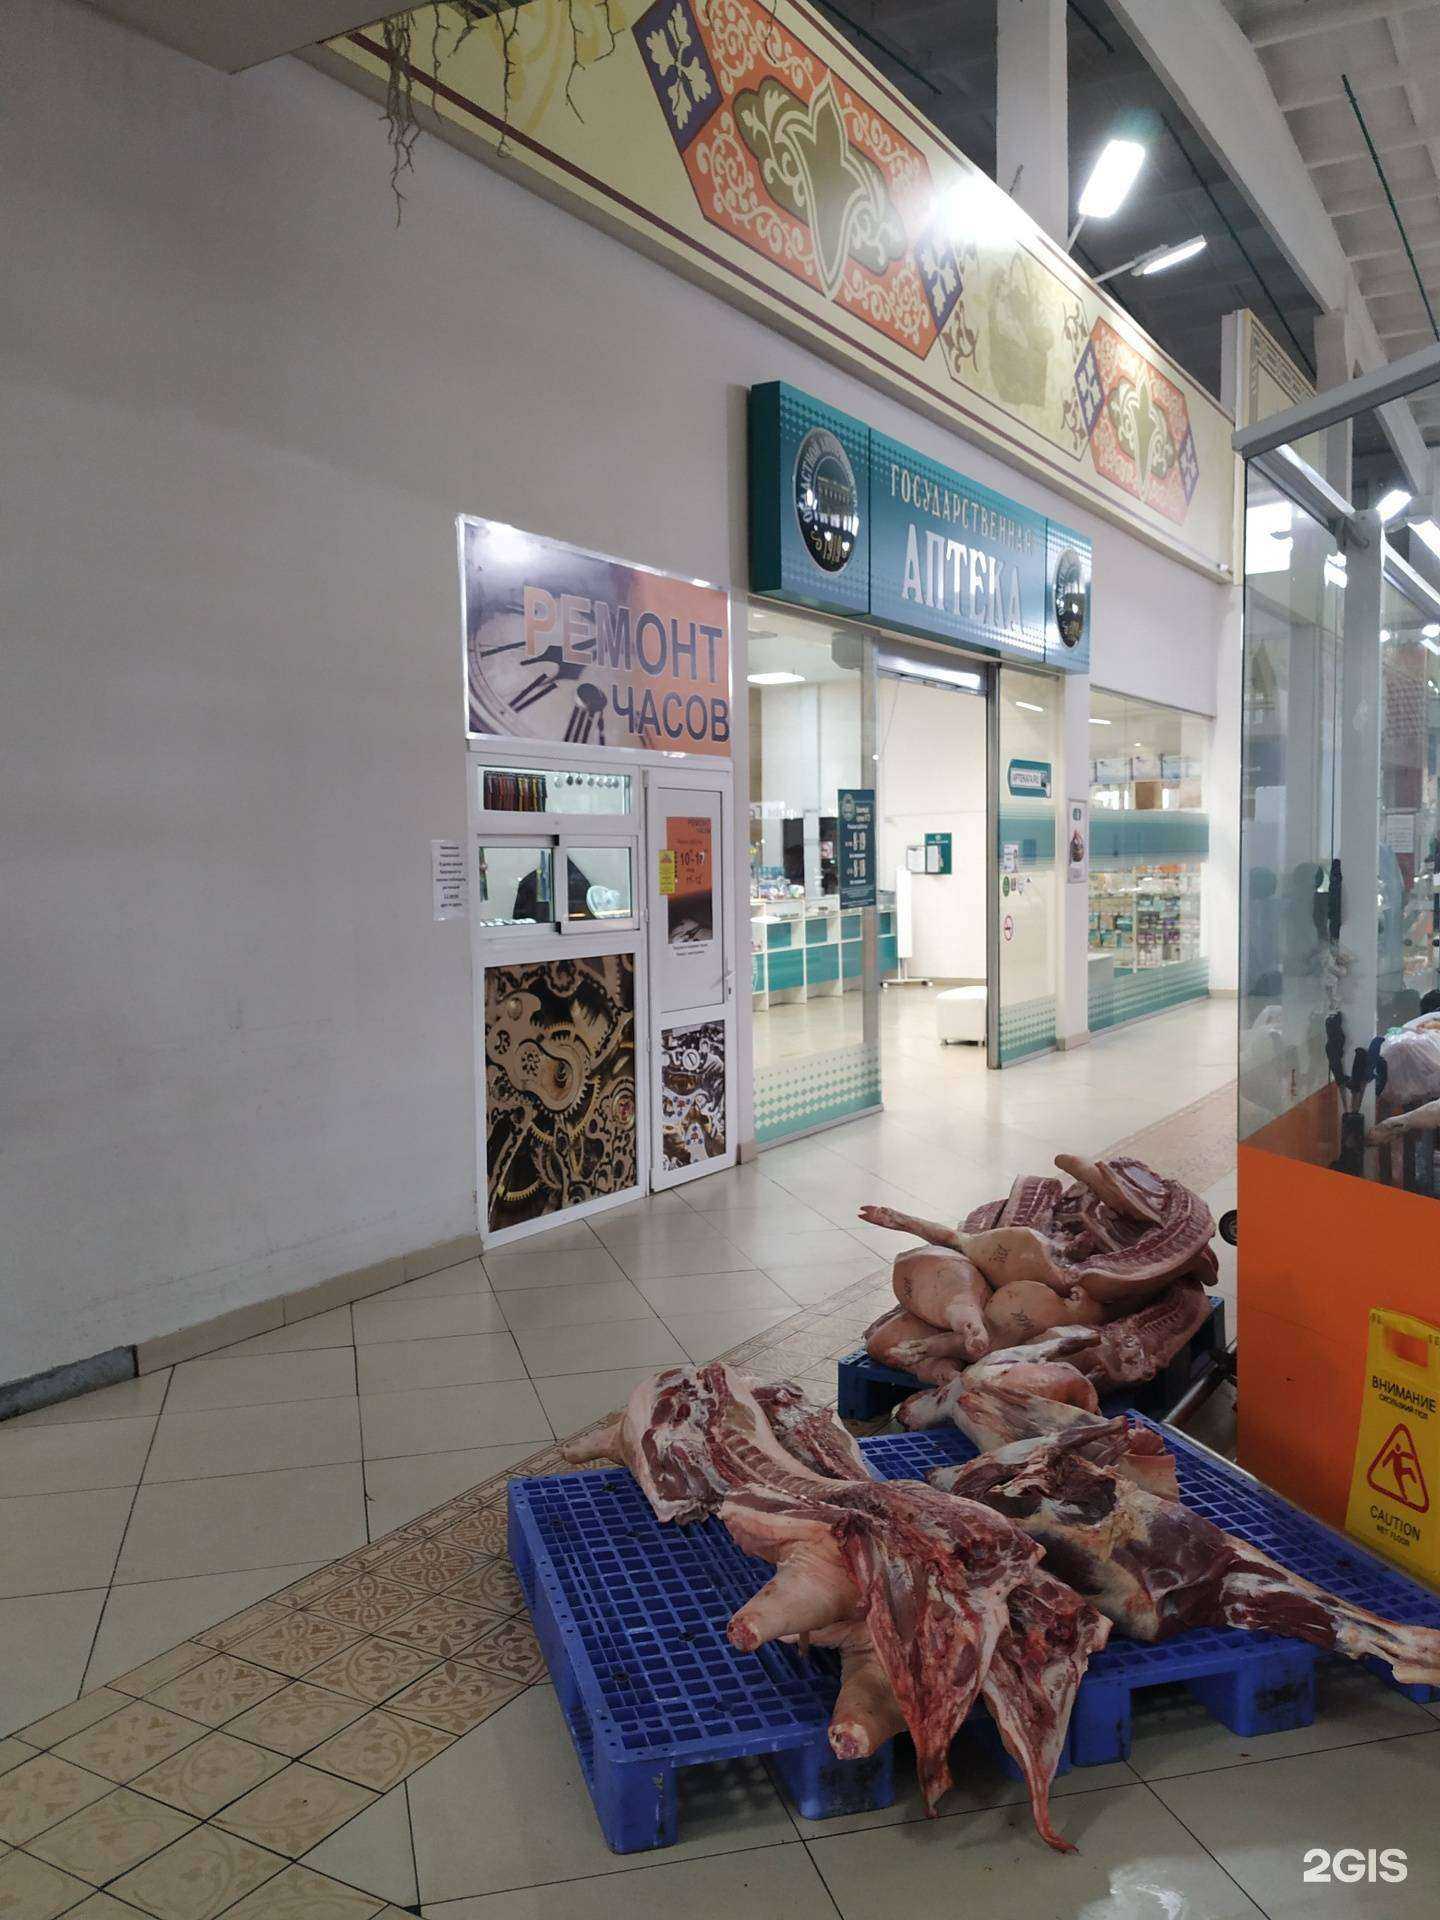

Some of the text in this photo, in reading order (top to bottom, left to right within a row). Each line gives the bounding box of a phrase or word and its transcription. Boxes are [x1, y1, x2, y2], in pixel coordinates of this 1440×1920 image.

[891, 464, 1034, 555] ГОСУДАРСТВЕННАЯ
[902, 523, 1025, 635] АПТЕКА
[523, 585, 723, 684] РЕМОНТ
[611, 684, 731, 743] ЧАСОВ
[1372, 1375, 1437, 1413] ВНИМАНИЕ
[1370, 1505, 1421, 1541] CAUTION
